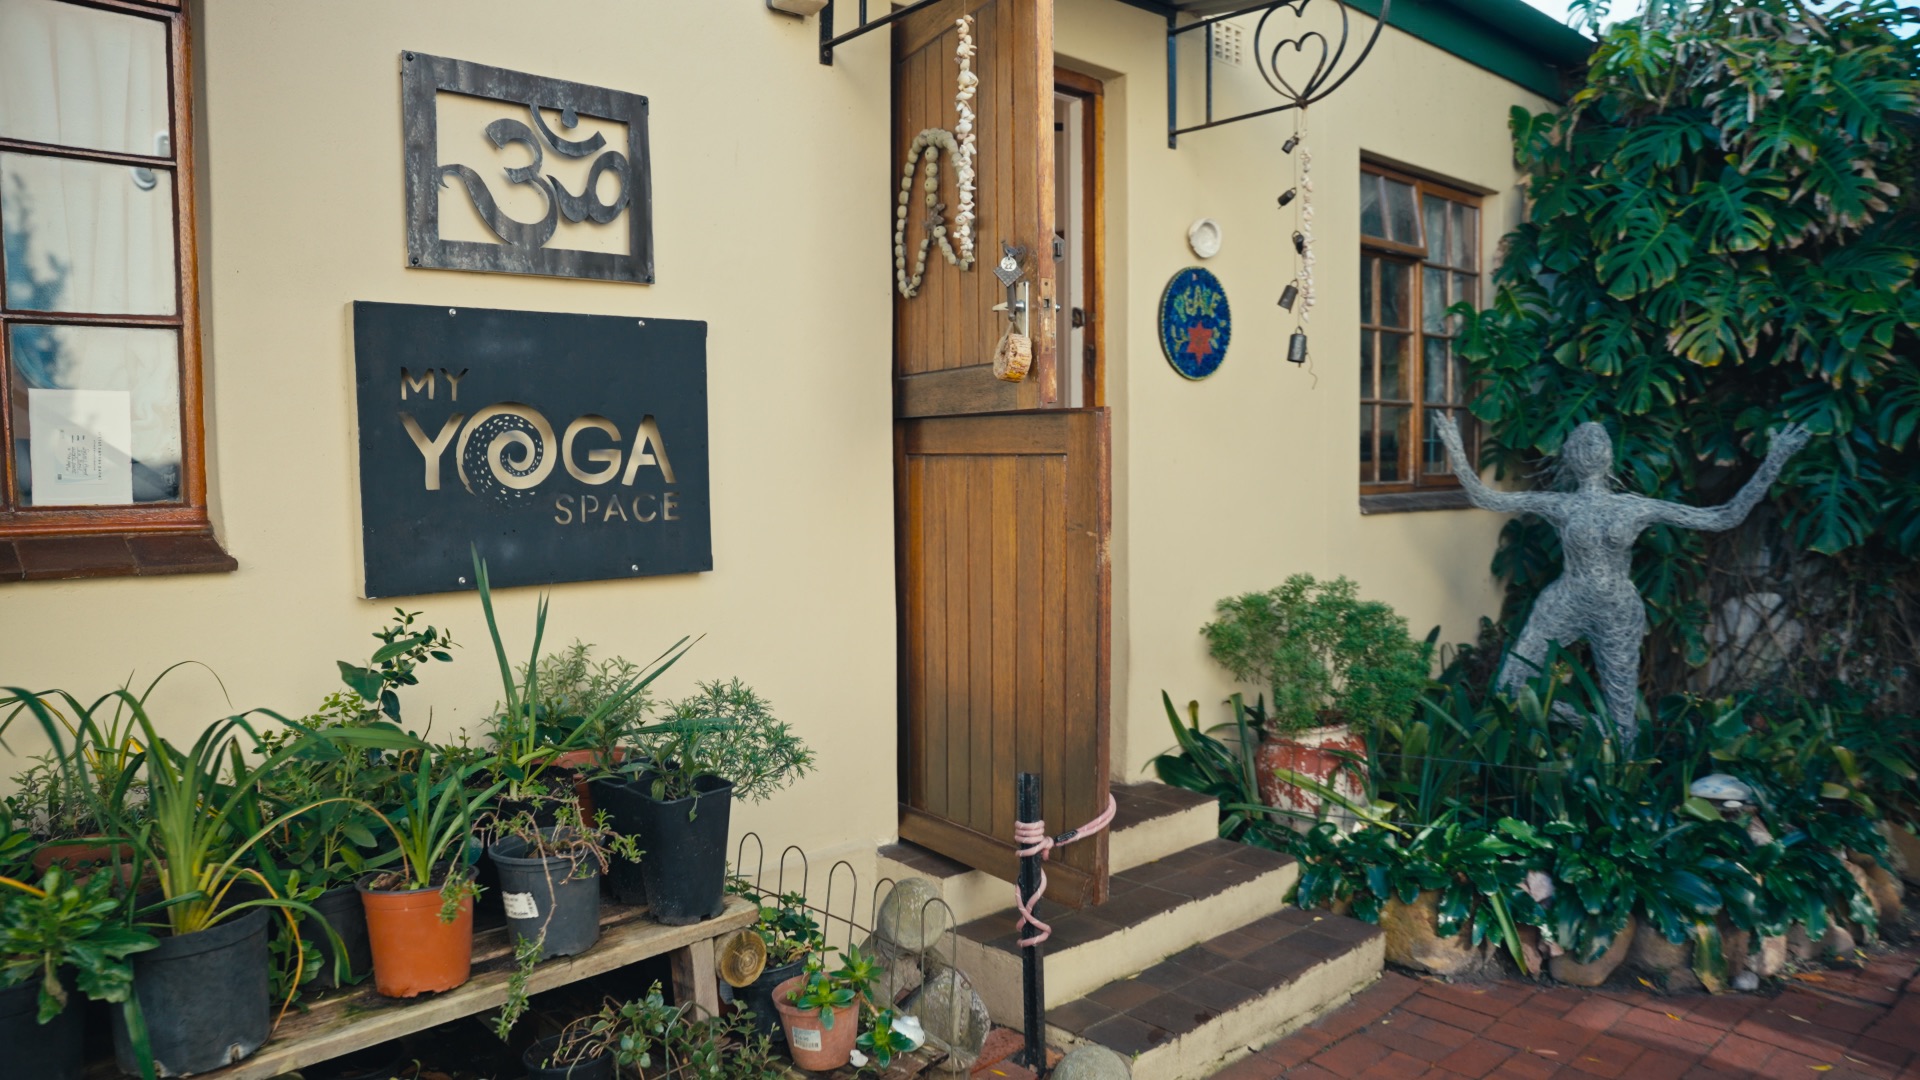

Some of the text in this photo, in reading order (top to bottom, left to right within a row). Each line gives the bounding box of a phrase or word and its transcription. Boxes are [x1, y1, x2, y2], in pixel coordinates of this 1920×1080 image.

[400, 366, 470, 401] MY
[398, 401, 678, 497] YOGA
[554, 492, 681, 525] SPACE
